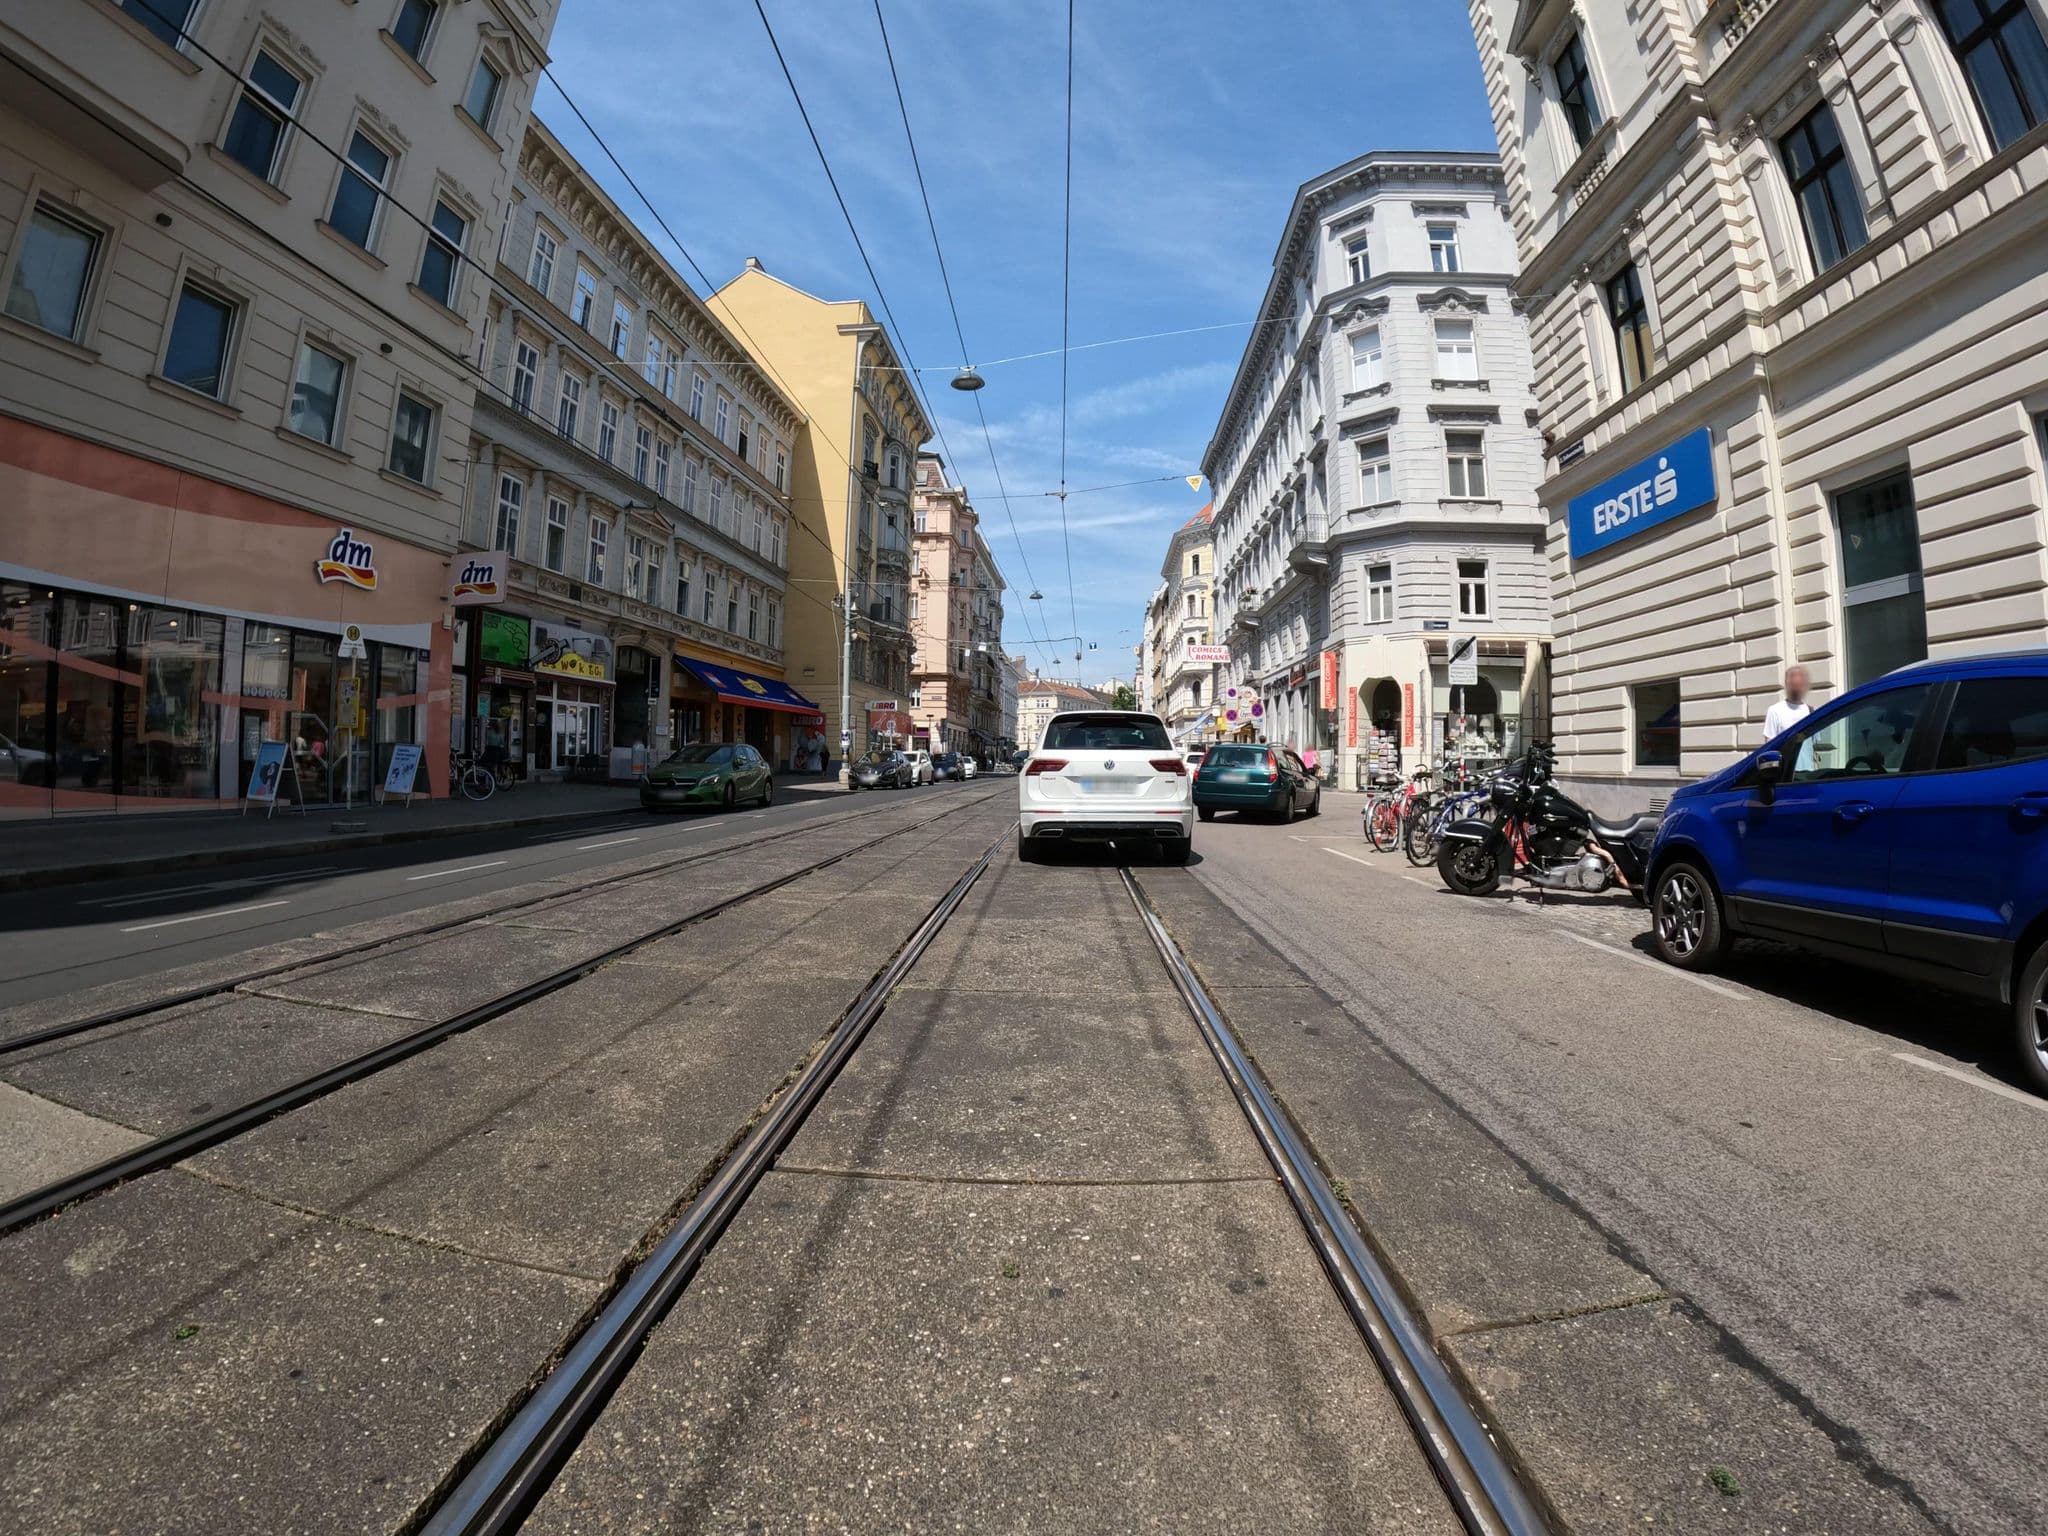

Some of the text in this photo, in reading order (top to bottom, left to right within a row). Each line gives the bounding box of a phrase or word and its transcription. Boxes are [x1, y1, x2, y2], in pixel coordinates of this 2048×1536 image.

[1593, 480, 1654, 535] ERSTE
[332, 531, 372, 568] dm
[461, 561, 493, 584] dm
[872, 702, 896, 710] LIBRO
